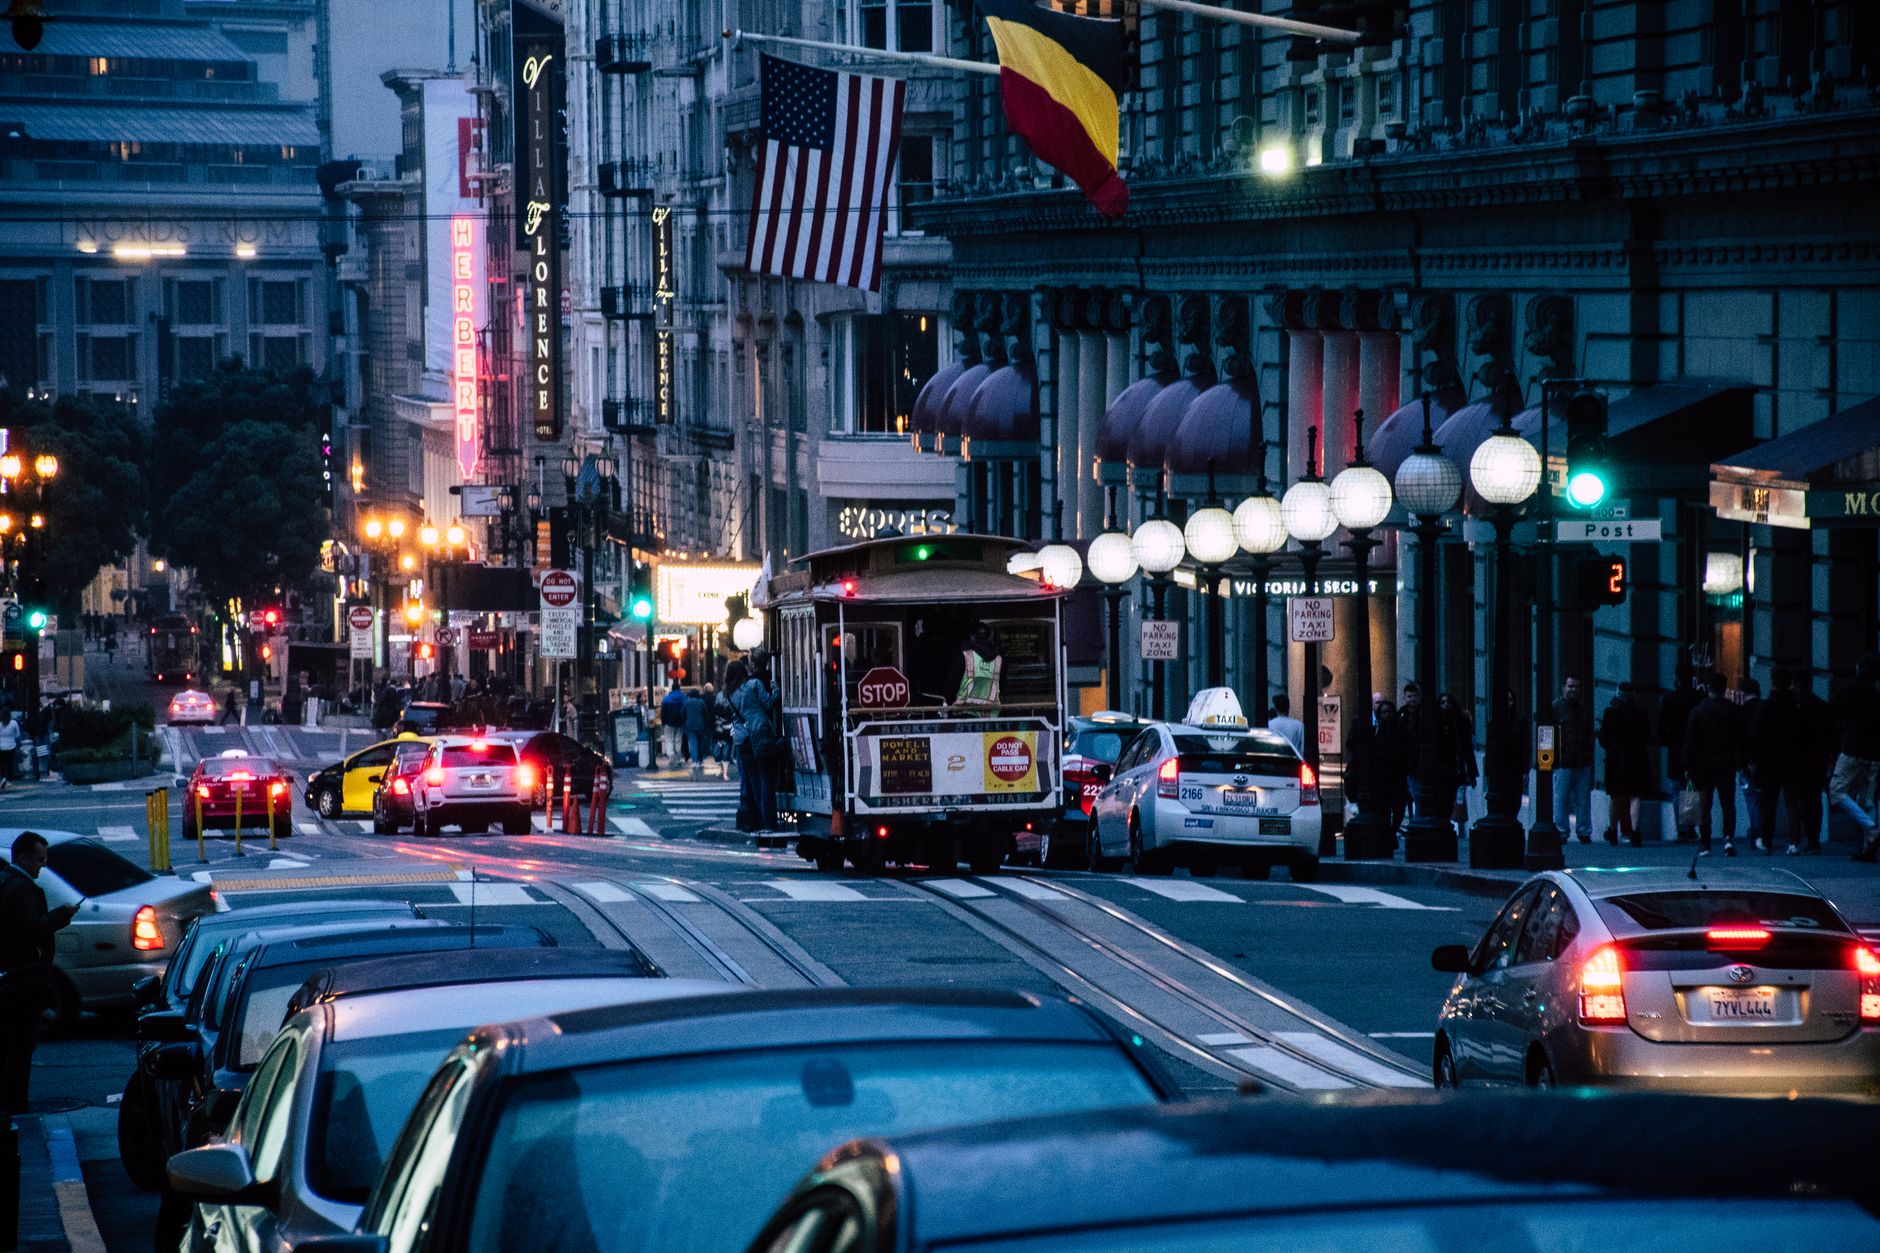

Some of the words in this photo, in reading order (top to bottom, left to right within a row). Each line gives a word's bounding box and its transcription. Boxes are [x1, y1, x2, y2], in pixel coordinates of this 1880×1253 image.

[523, 54, 552, 197] VILLA
[652, 207, 671, 287] VILLA
[524, 201, 551, 410] FLORENCE
[455, 221, 474, 441] HERBERT
[1585, 524, 1633, 537] Post
[1610, 563, 1623, 593] 2
[1305, 601, 1321, 610] NO
[1295, 610, 1331, 619] PARKING
[1301, 621, 1326, 630] TAXI
[660, 627, 689, 635] GEARY
[1143, 632, 1176, 640] PARKING
[1298, 630, 1328, 638] ZONE
[1149, 641, 1171, 649] TAXI
[861, 682, 907, 703] STOP
[1217, 714, 1236, 724] TAXI
[880, 724, 939, 734] MARKET
[882, 740, 929, 749] POWELL
[1008, 742, 1023, 750] NOT
[881, 753, 929, 761] MARKET
[947, 755, 966, 771] 2
[987, 792, 1033, 803] WHARF
[1182, 788, 1203, 800] 2166
[1713, 1000, 1772, 1017] 7YVL444
